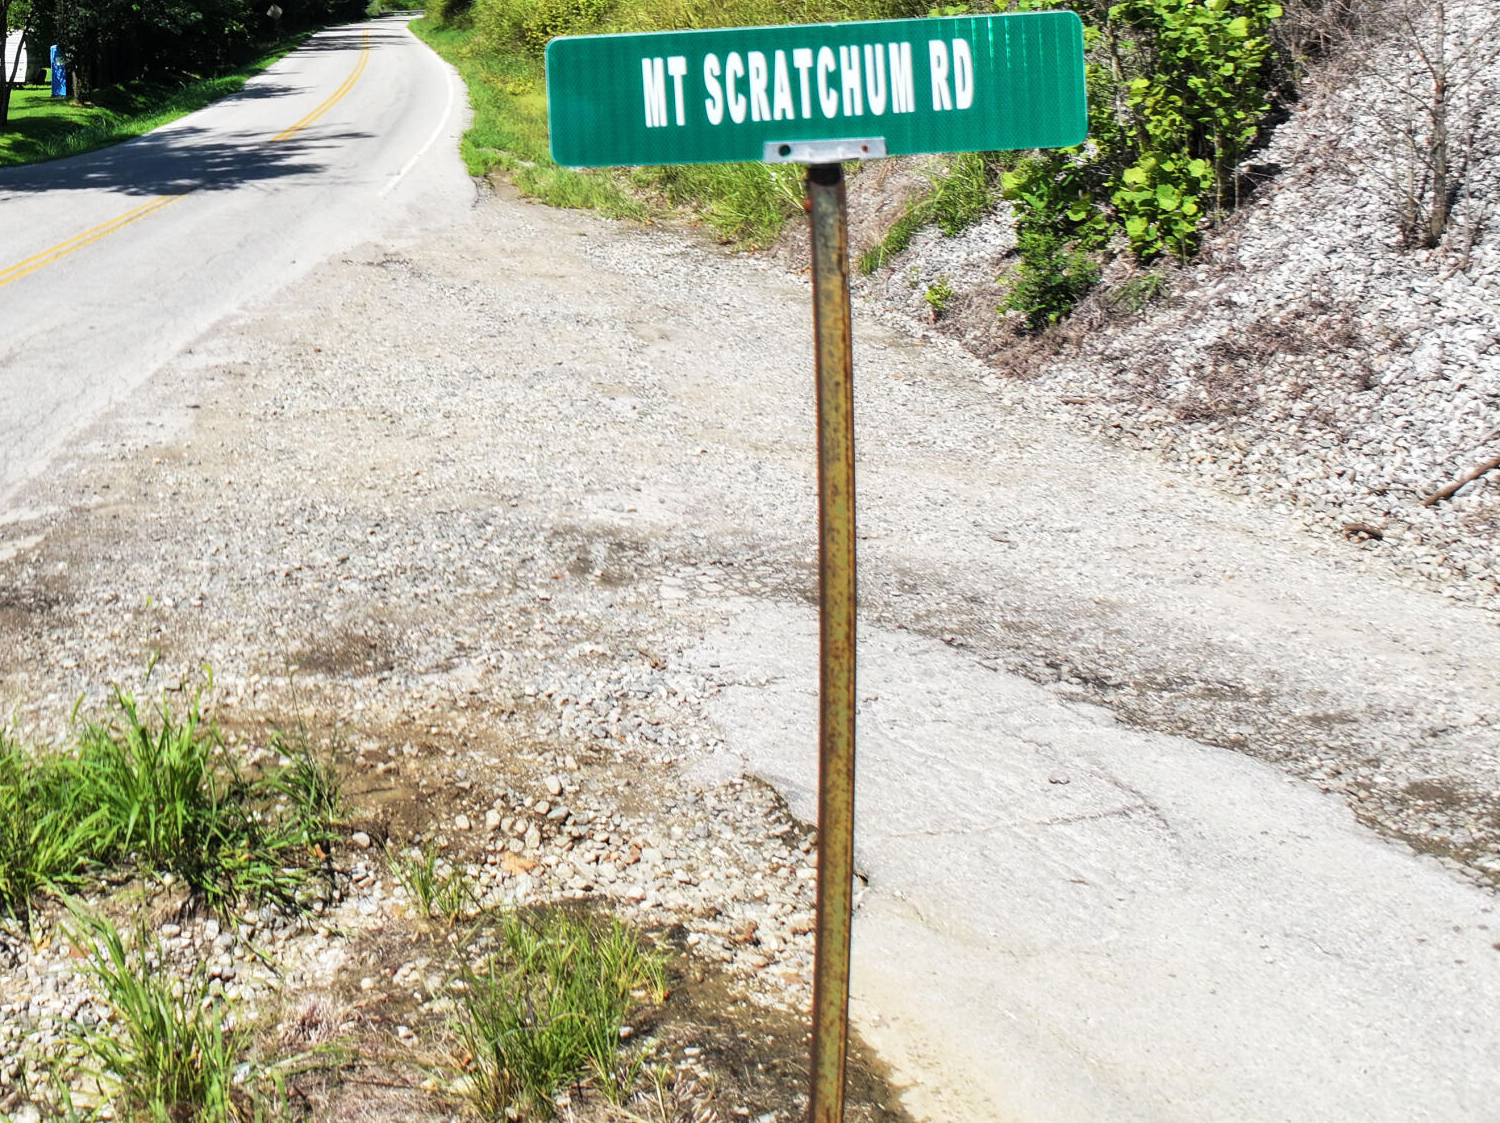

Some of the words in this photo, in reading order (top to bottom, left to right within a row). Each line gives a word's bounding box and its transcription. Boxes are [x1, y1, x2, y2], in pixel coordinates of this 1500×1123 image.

[641, 55, 687, 128] MT
[703, 42, 915, 126] SCRATCHUM
[928, 38, 974, 111] RD
